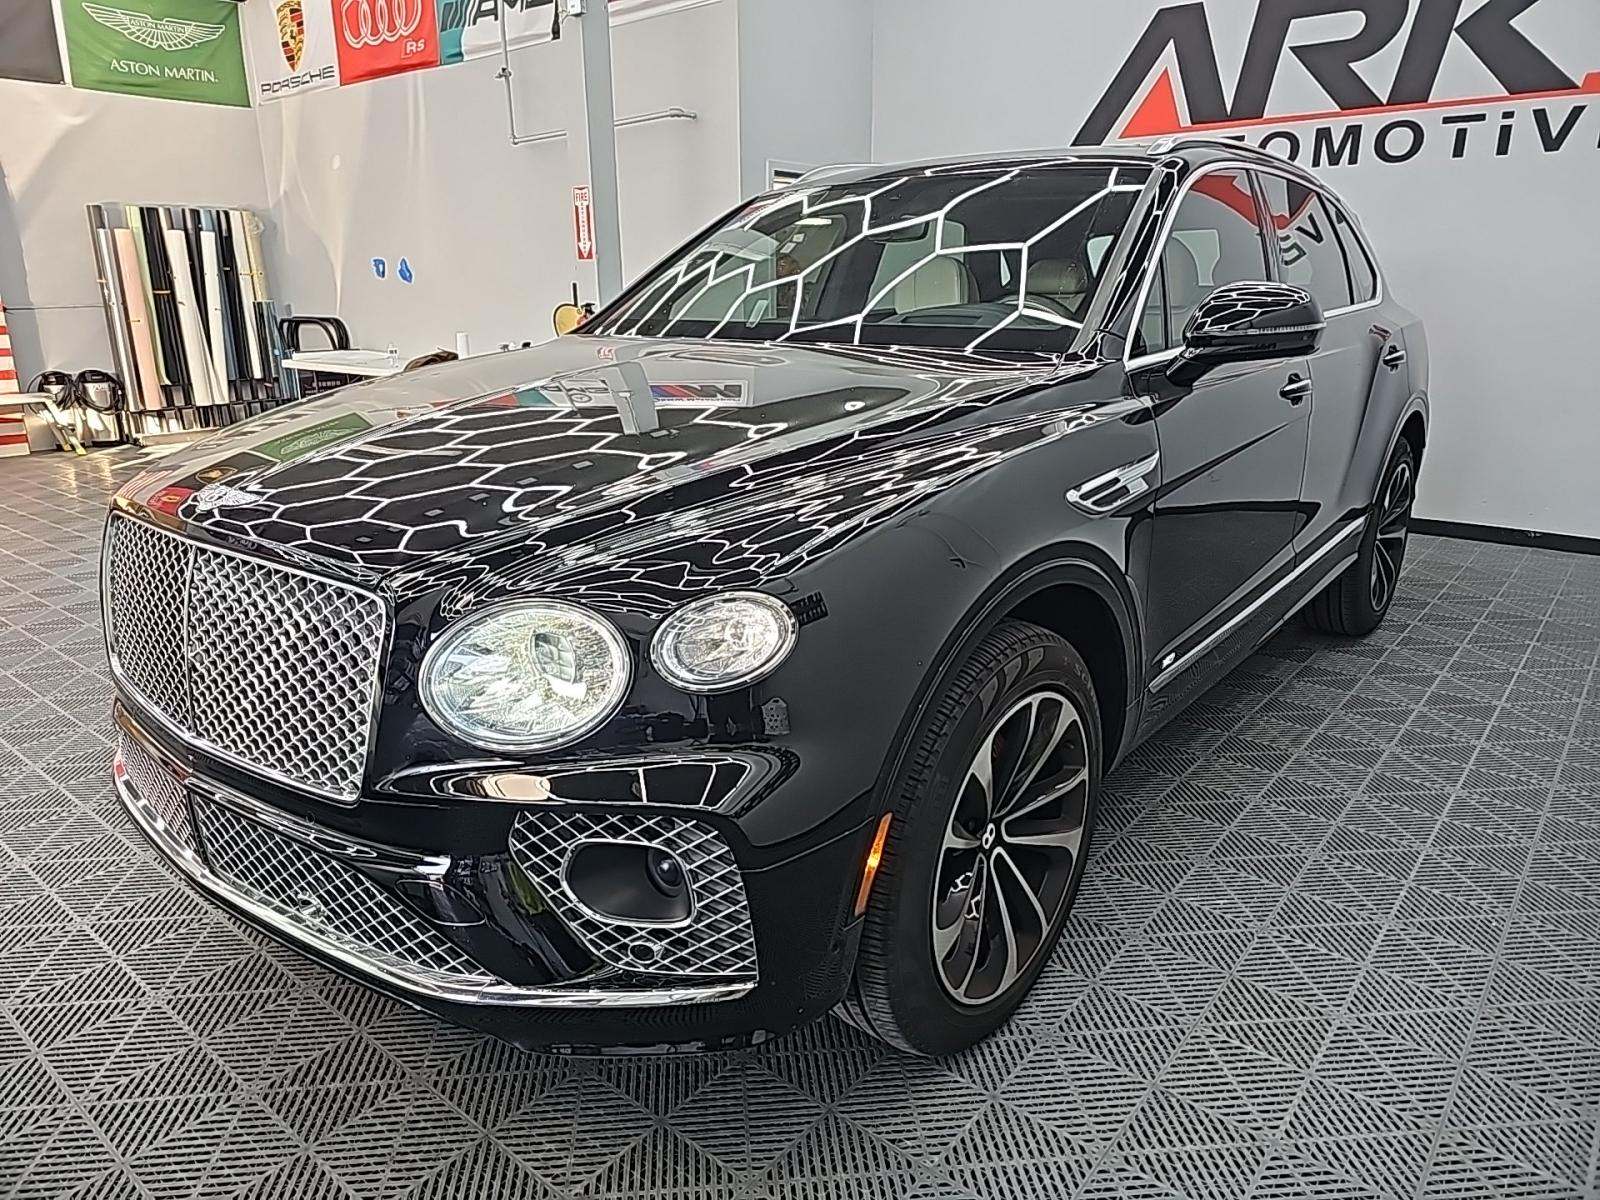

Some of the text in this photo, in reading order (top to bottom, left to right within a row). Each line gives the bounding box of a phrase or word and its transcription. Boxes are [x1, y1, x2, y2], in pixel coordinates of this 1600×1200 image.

[405, 39, 425, 55] RS
[110, 58, 160, 77] ASTON
[1071, 0, 1580, 147] ARK
[260, 65, 336, 96] PORSCHE
[1220, 104, 1600, 168] OMOTiV
[575, 192, 588, 202] FIRE
